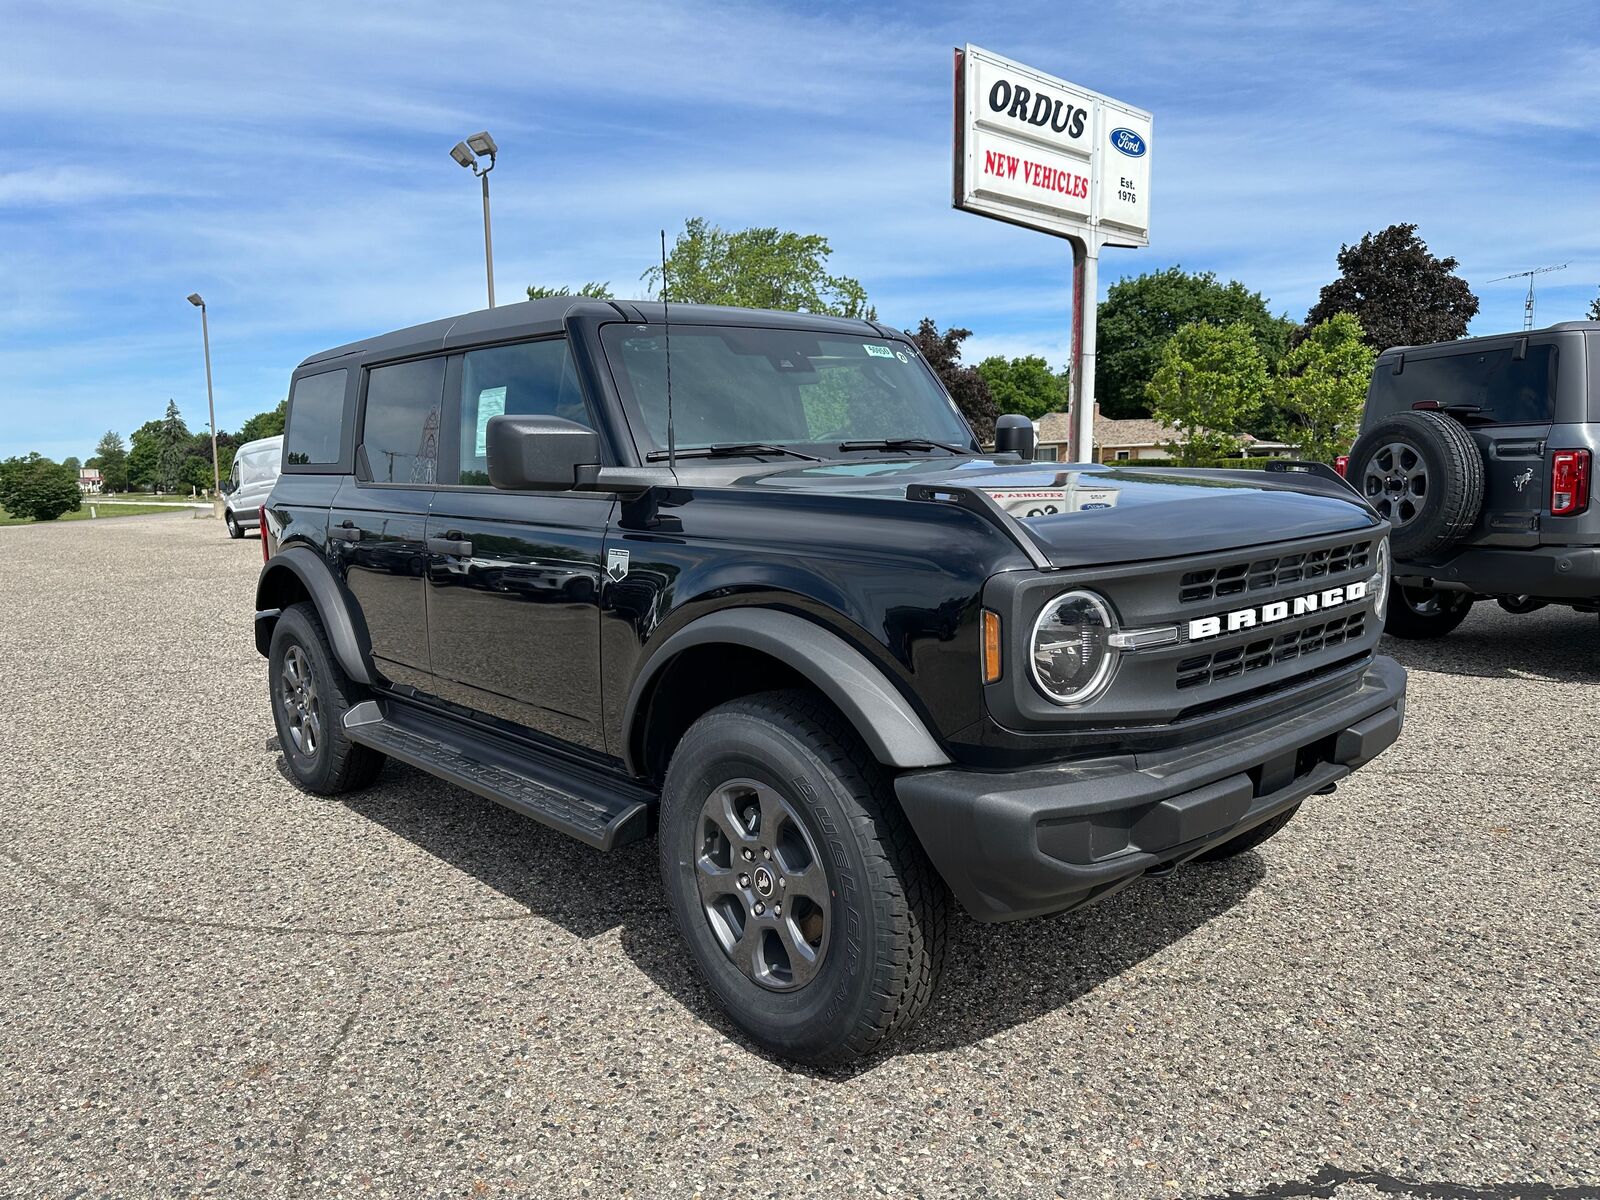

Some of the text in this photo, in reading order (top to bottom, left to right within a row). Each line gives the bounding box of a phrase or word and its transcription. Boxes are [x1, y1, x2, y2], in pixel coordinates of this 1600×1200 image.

[988, 80, 1087, 139] ORDUS
[1116, 130, 1141, 154] Ford
[984, 150, 1089, 199] NEW VEHICLES
[1117, 190, 1137, 204] 1976
[1120, 176, 1136, 190] Est.
[1189, 581, 1367, 640] BRONCO
[792, 774, 862, 977] DUELER
